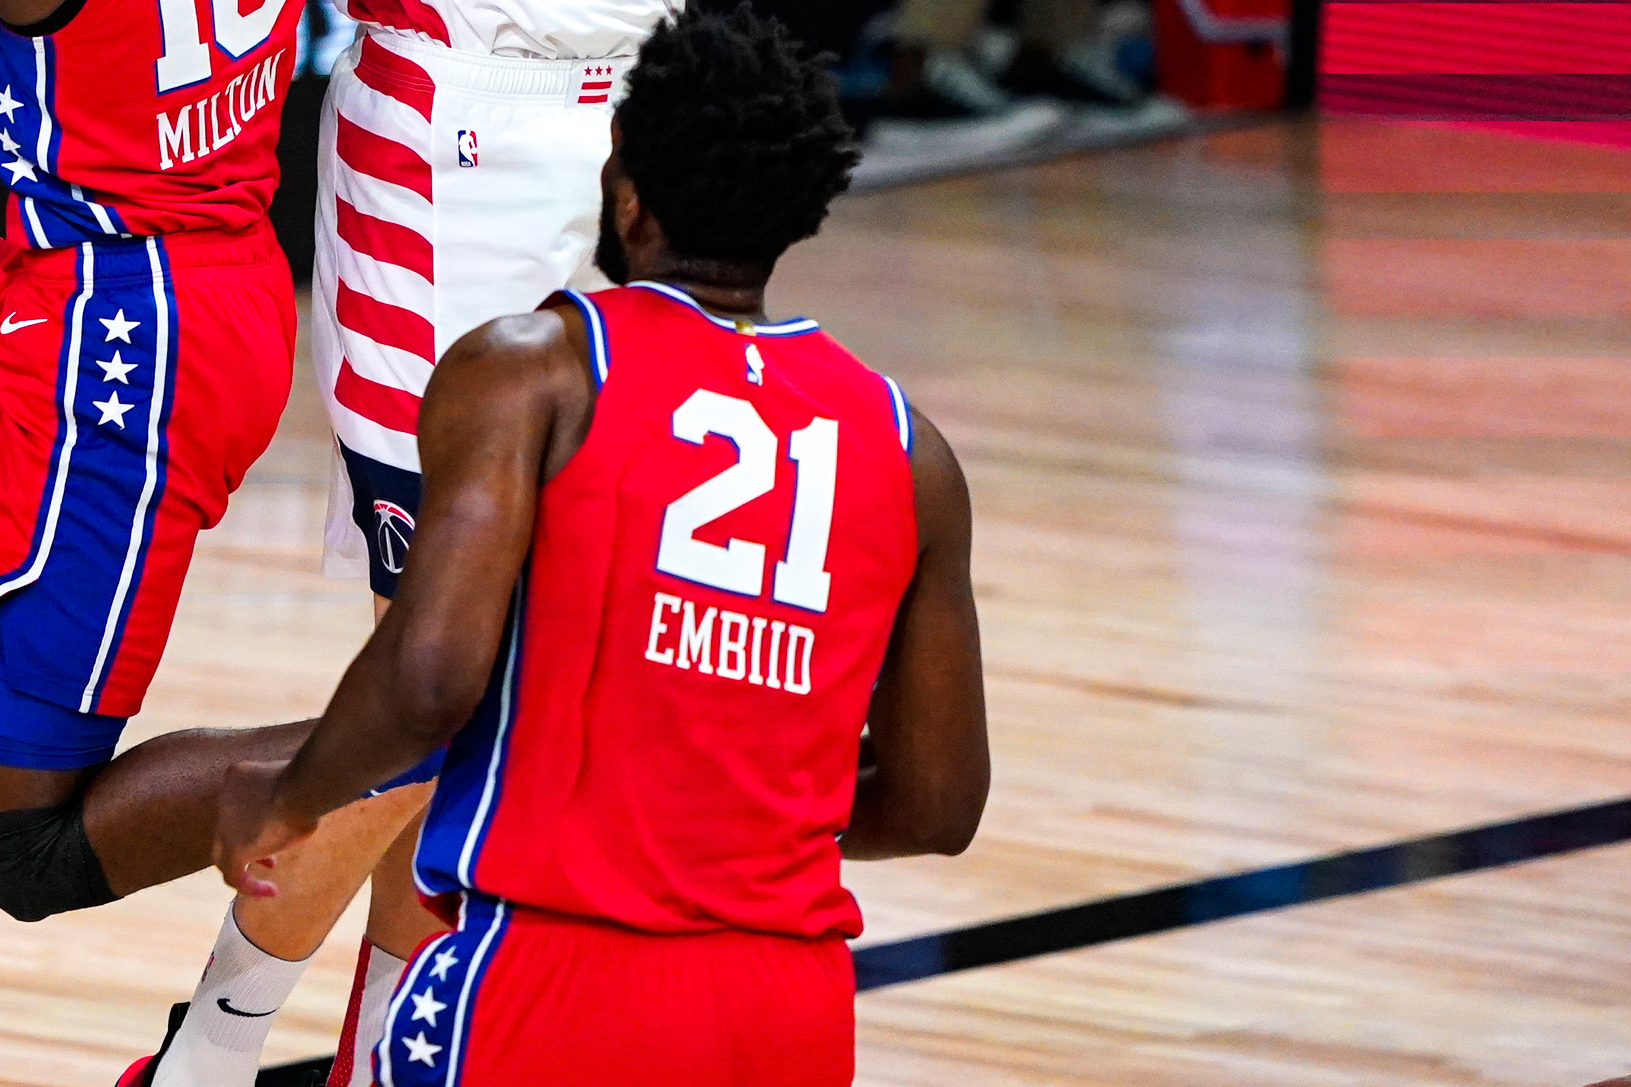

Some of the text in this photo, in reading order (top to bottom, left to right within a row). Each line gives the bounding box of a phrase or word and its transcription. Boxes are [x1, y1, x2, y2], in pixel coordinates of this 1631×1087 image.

[156, 47, 287, 171] MILTON
[654, 387, 840, 614] 21
[644, 591, 816, 696] EMBIID
